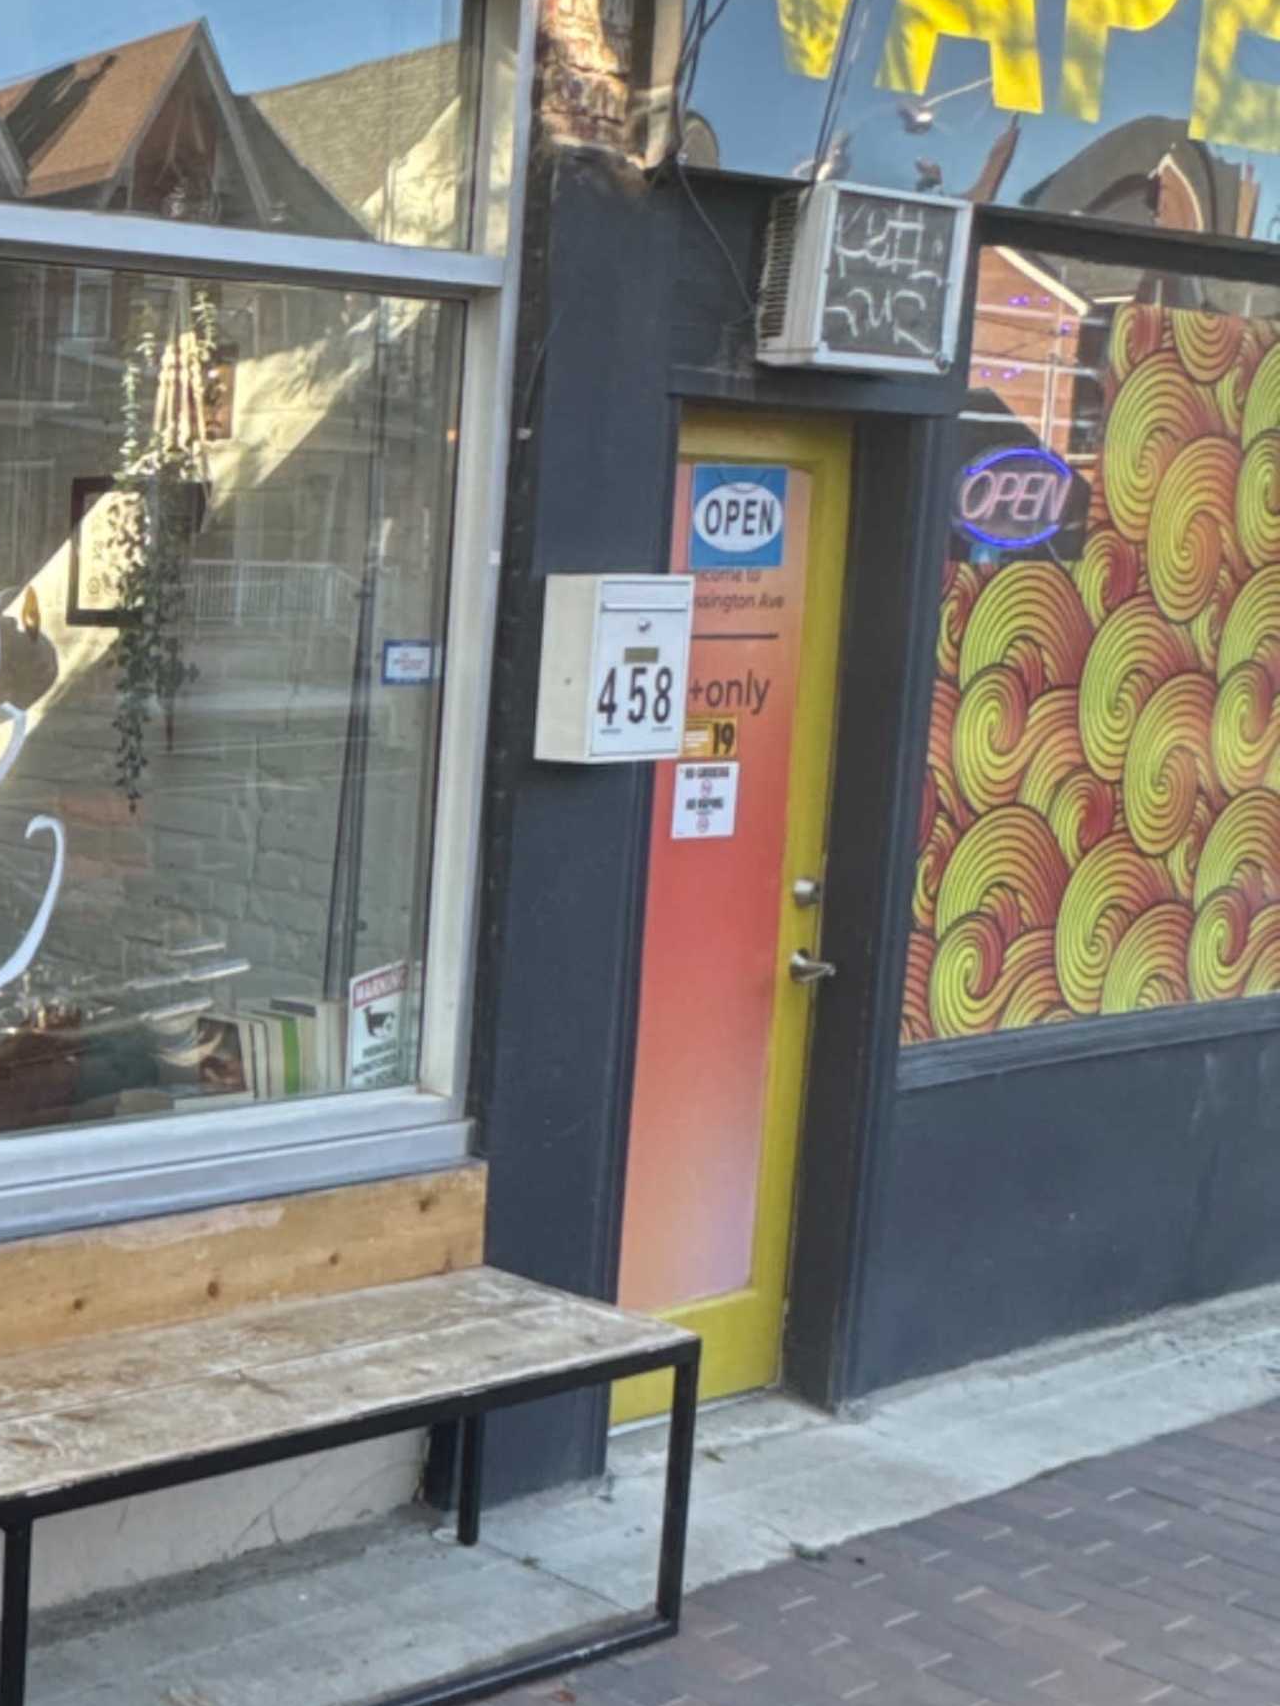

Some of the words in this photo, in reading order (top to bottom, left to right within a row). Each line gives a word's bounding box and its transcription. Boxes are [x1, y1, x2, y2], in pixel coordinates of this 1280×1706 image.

[704, 498, 776, 537] OPEN
[960, 469, 1072, 522] OPEN
[596, 665, 673, 726] 458
[713, 722, 735, 755] 19
